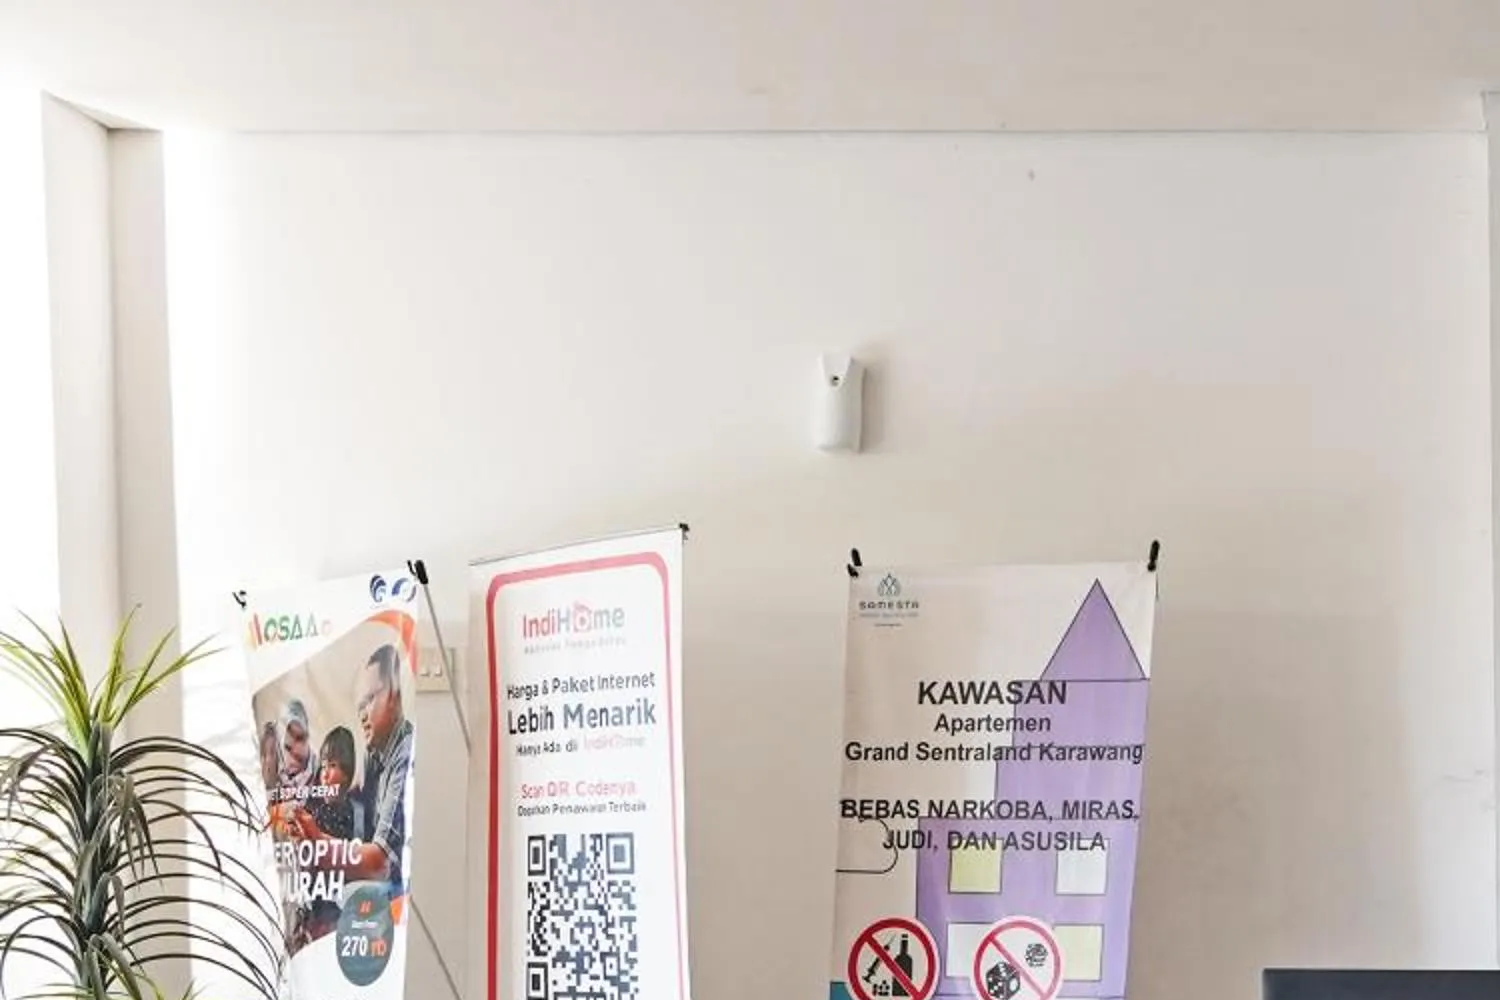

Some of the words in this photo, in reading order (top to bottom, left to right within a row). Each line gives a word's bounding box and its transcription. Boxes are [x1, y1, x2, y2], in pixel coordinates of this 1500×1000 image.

[523, 602, 625, 640] IndiHome
[507, 680, 539, 701] Harga
[541, 680, 549, 695] &
[552, 675, 594, 694] Paket
[597, 672, 655, 691] Internet
[917, 680, 1067, 705] KAWASAN
[507, 705, 554, 735] Lebih
[563, 699, 656, 729] Menarik
[934, 713, 1051, 736] Apartemen
[845, 742, 909, 761] Grand
[915, 742, 1031, 762] Sentraland
[1039, 744, 1143, 764] Karawang
[547, 781, 569, 797] QR
[841, 799, 919, 819] BEBAS
[928, 800, 1053, 822] NARKOBA,
[299, 837, 362, 866] OPTIC
[883, 830, 938, 851] JUDI,
[948, 831, 1002, 851] DAN
[1004, 831, 1106, 851] ASUSILA
[288, 869, 345, 903] URAH
[341, 935, 369, 957] 270
